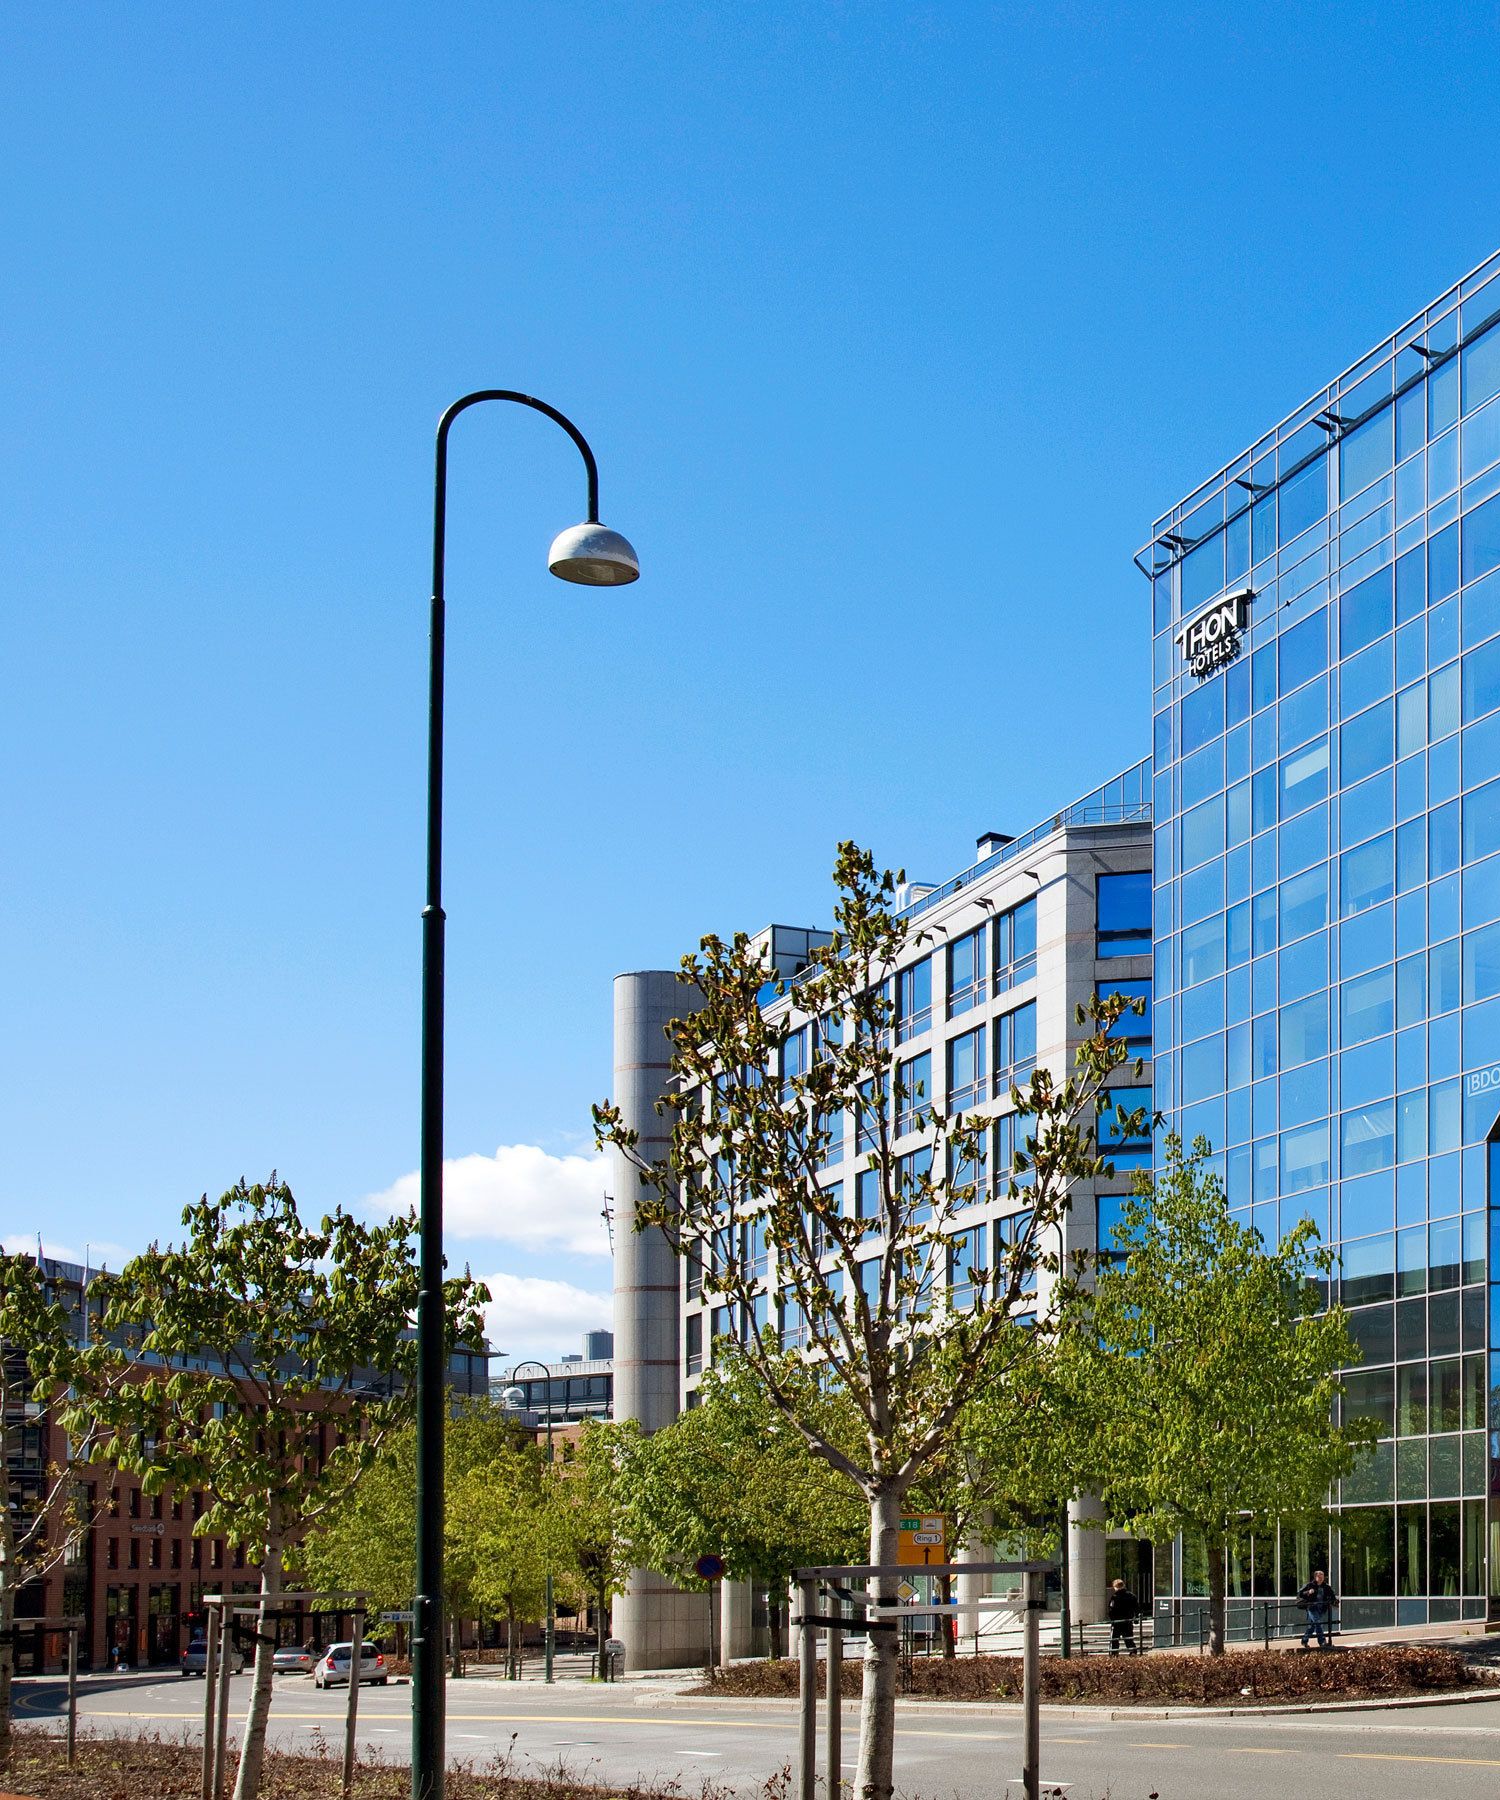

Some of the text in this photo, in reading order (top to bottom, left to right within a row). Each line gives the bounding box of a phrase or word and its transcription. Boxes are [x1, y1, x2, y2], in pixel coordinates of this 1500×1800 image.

[1174, 588, 1251, 661] THON
[1189, 636, 1232, 677] HOTELS
[900, 1521, 918, 1529] E 18
